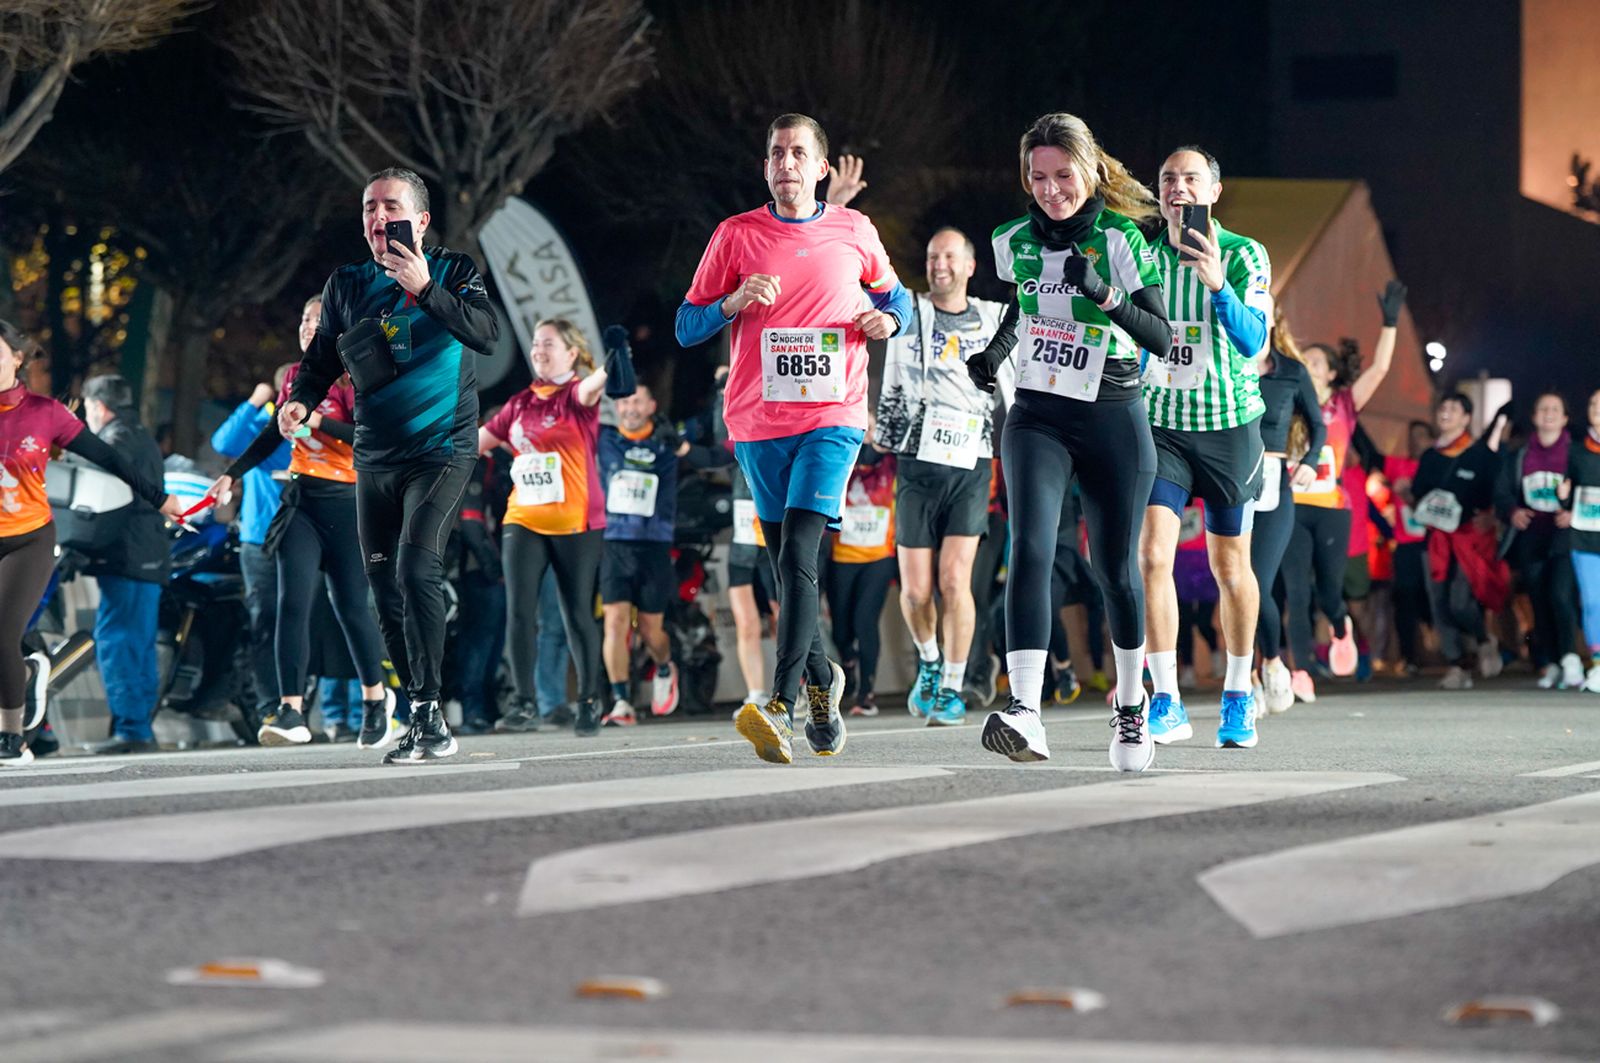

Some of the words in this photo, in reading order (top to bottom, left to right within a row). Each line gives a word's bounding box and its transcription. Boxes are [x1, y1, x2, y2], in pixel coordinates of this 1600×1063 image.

[1030, 326, 1044, 337] SAN
[1040, 319, 1066, 330] NOCHE
[1067, 323, 1077, 333] DE
[780, 335, 803, 343] NOCHE
[805, 335, 814, 343] DE
[1031, 337, 1089, 370] 2550
[776, 354, 831, 376] 6853
[933, 428, 970, 448] 4502
